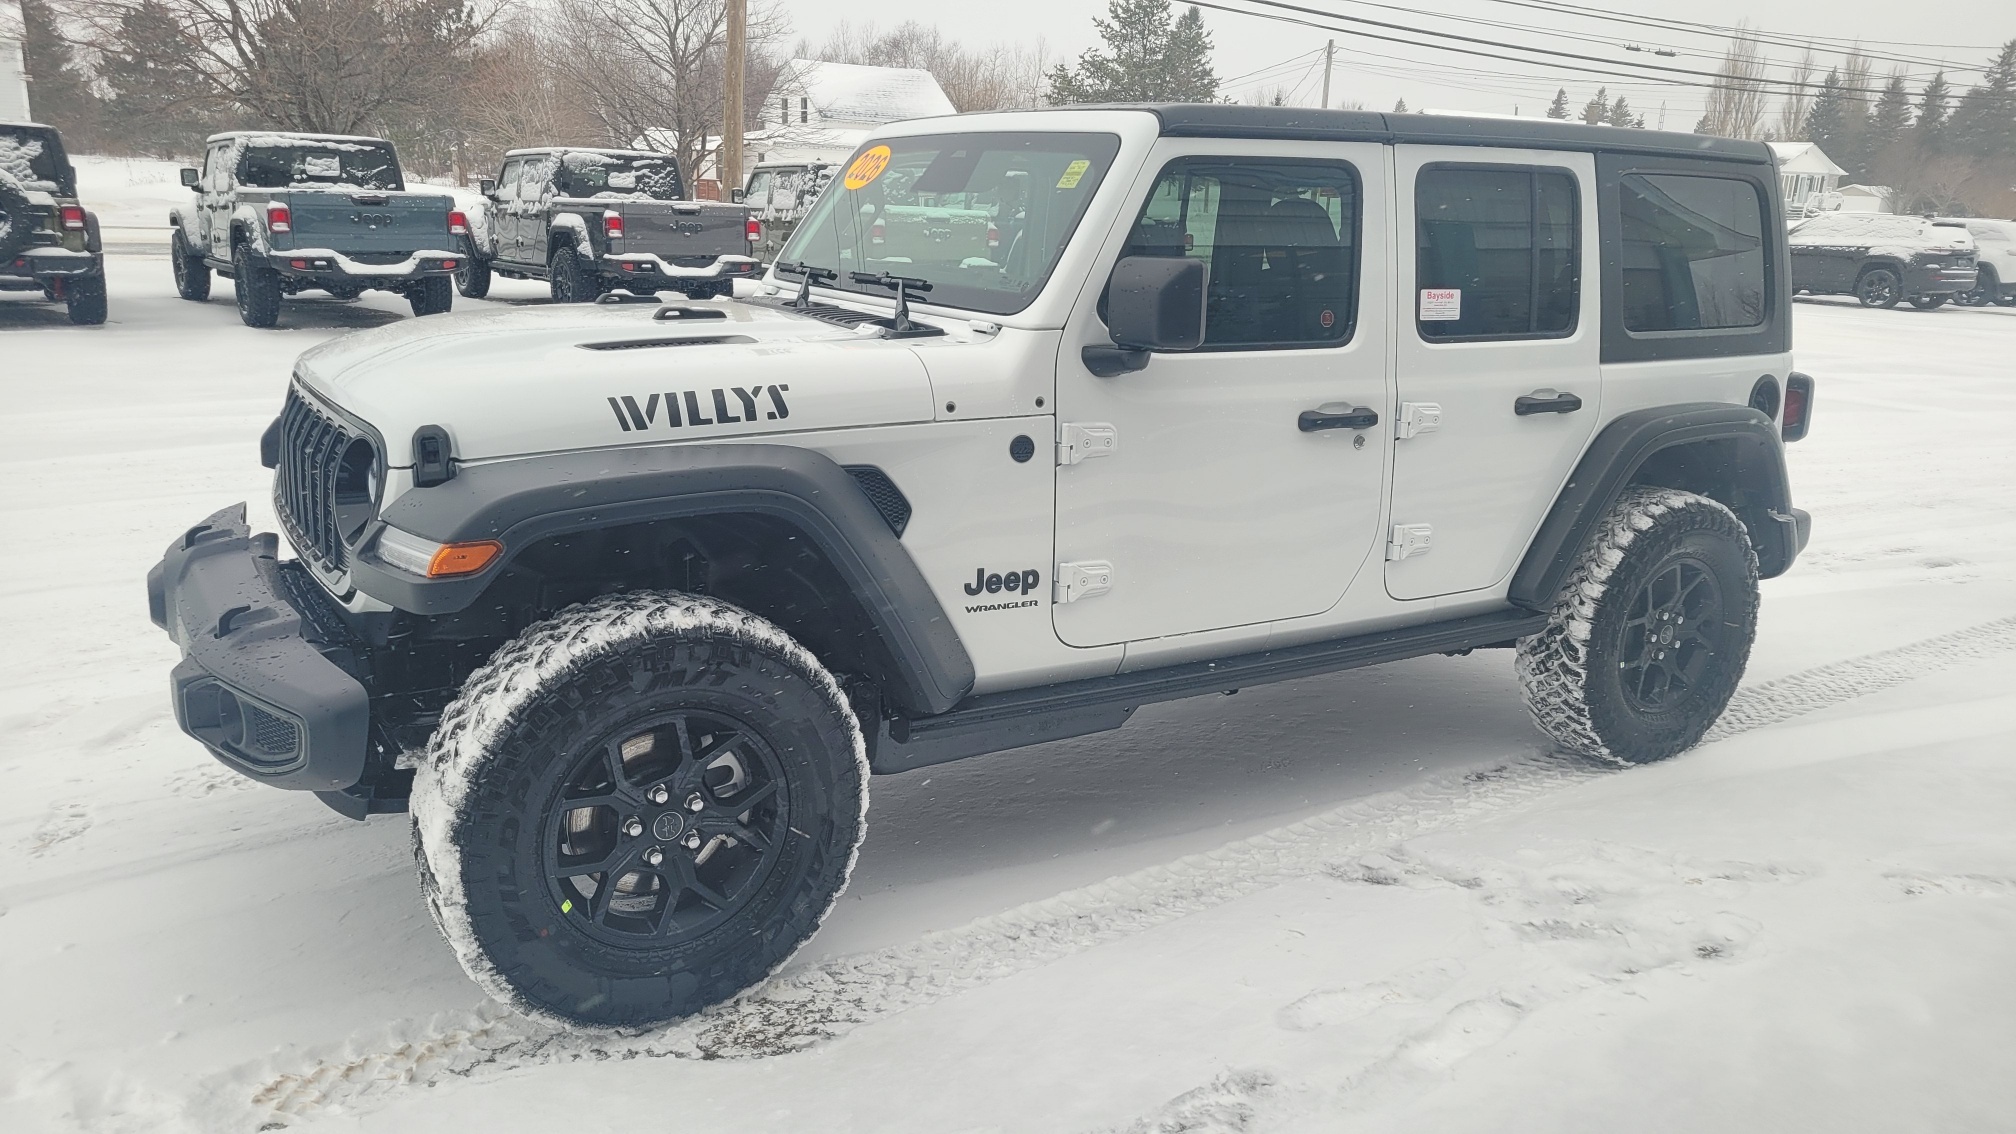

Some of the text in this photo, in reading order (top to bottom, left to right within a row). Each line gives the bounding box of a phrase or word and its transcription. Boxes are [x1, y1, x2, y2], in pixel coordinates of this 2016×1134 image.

[848, 153, 888, 181] 2026
[350, 211, 393, 228] Jeep
[669, 219, 704, 235] Jeep
[1427, 291, 1454, 301] Bayside
[607, 384, 790, 432] WILLYS
[963, 567, 1040, 596] Jeep
[964, 599, 1039, 613] WRANGLER
